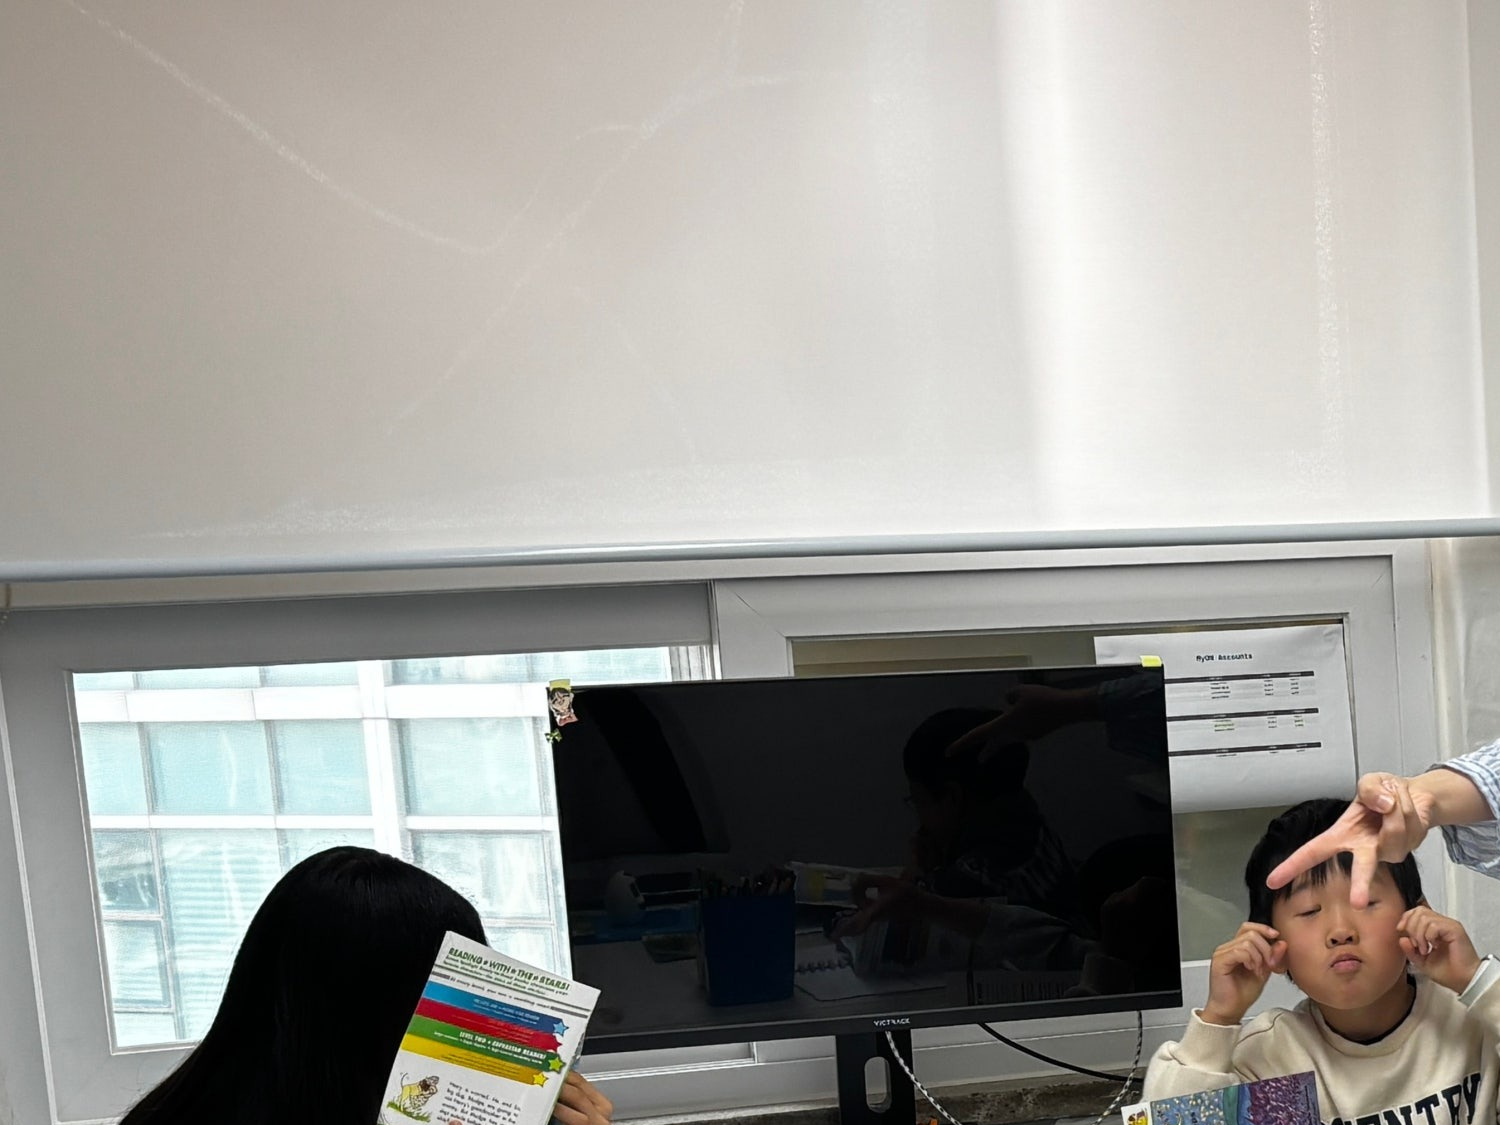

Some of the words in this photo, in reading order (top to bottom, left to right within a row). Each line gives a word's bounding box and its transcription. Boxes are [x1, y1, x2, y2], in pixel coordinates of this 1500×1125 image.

[448, 943, 484, 966] READING
[488, 958, 511, 974] WITH
[516, 967, 534, 981] THE
